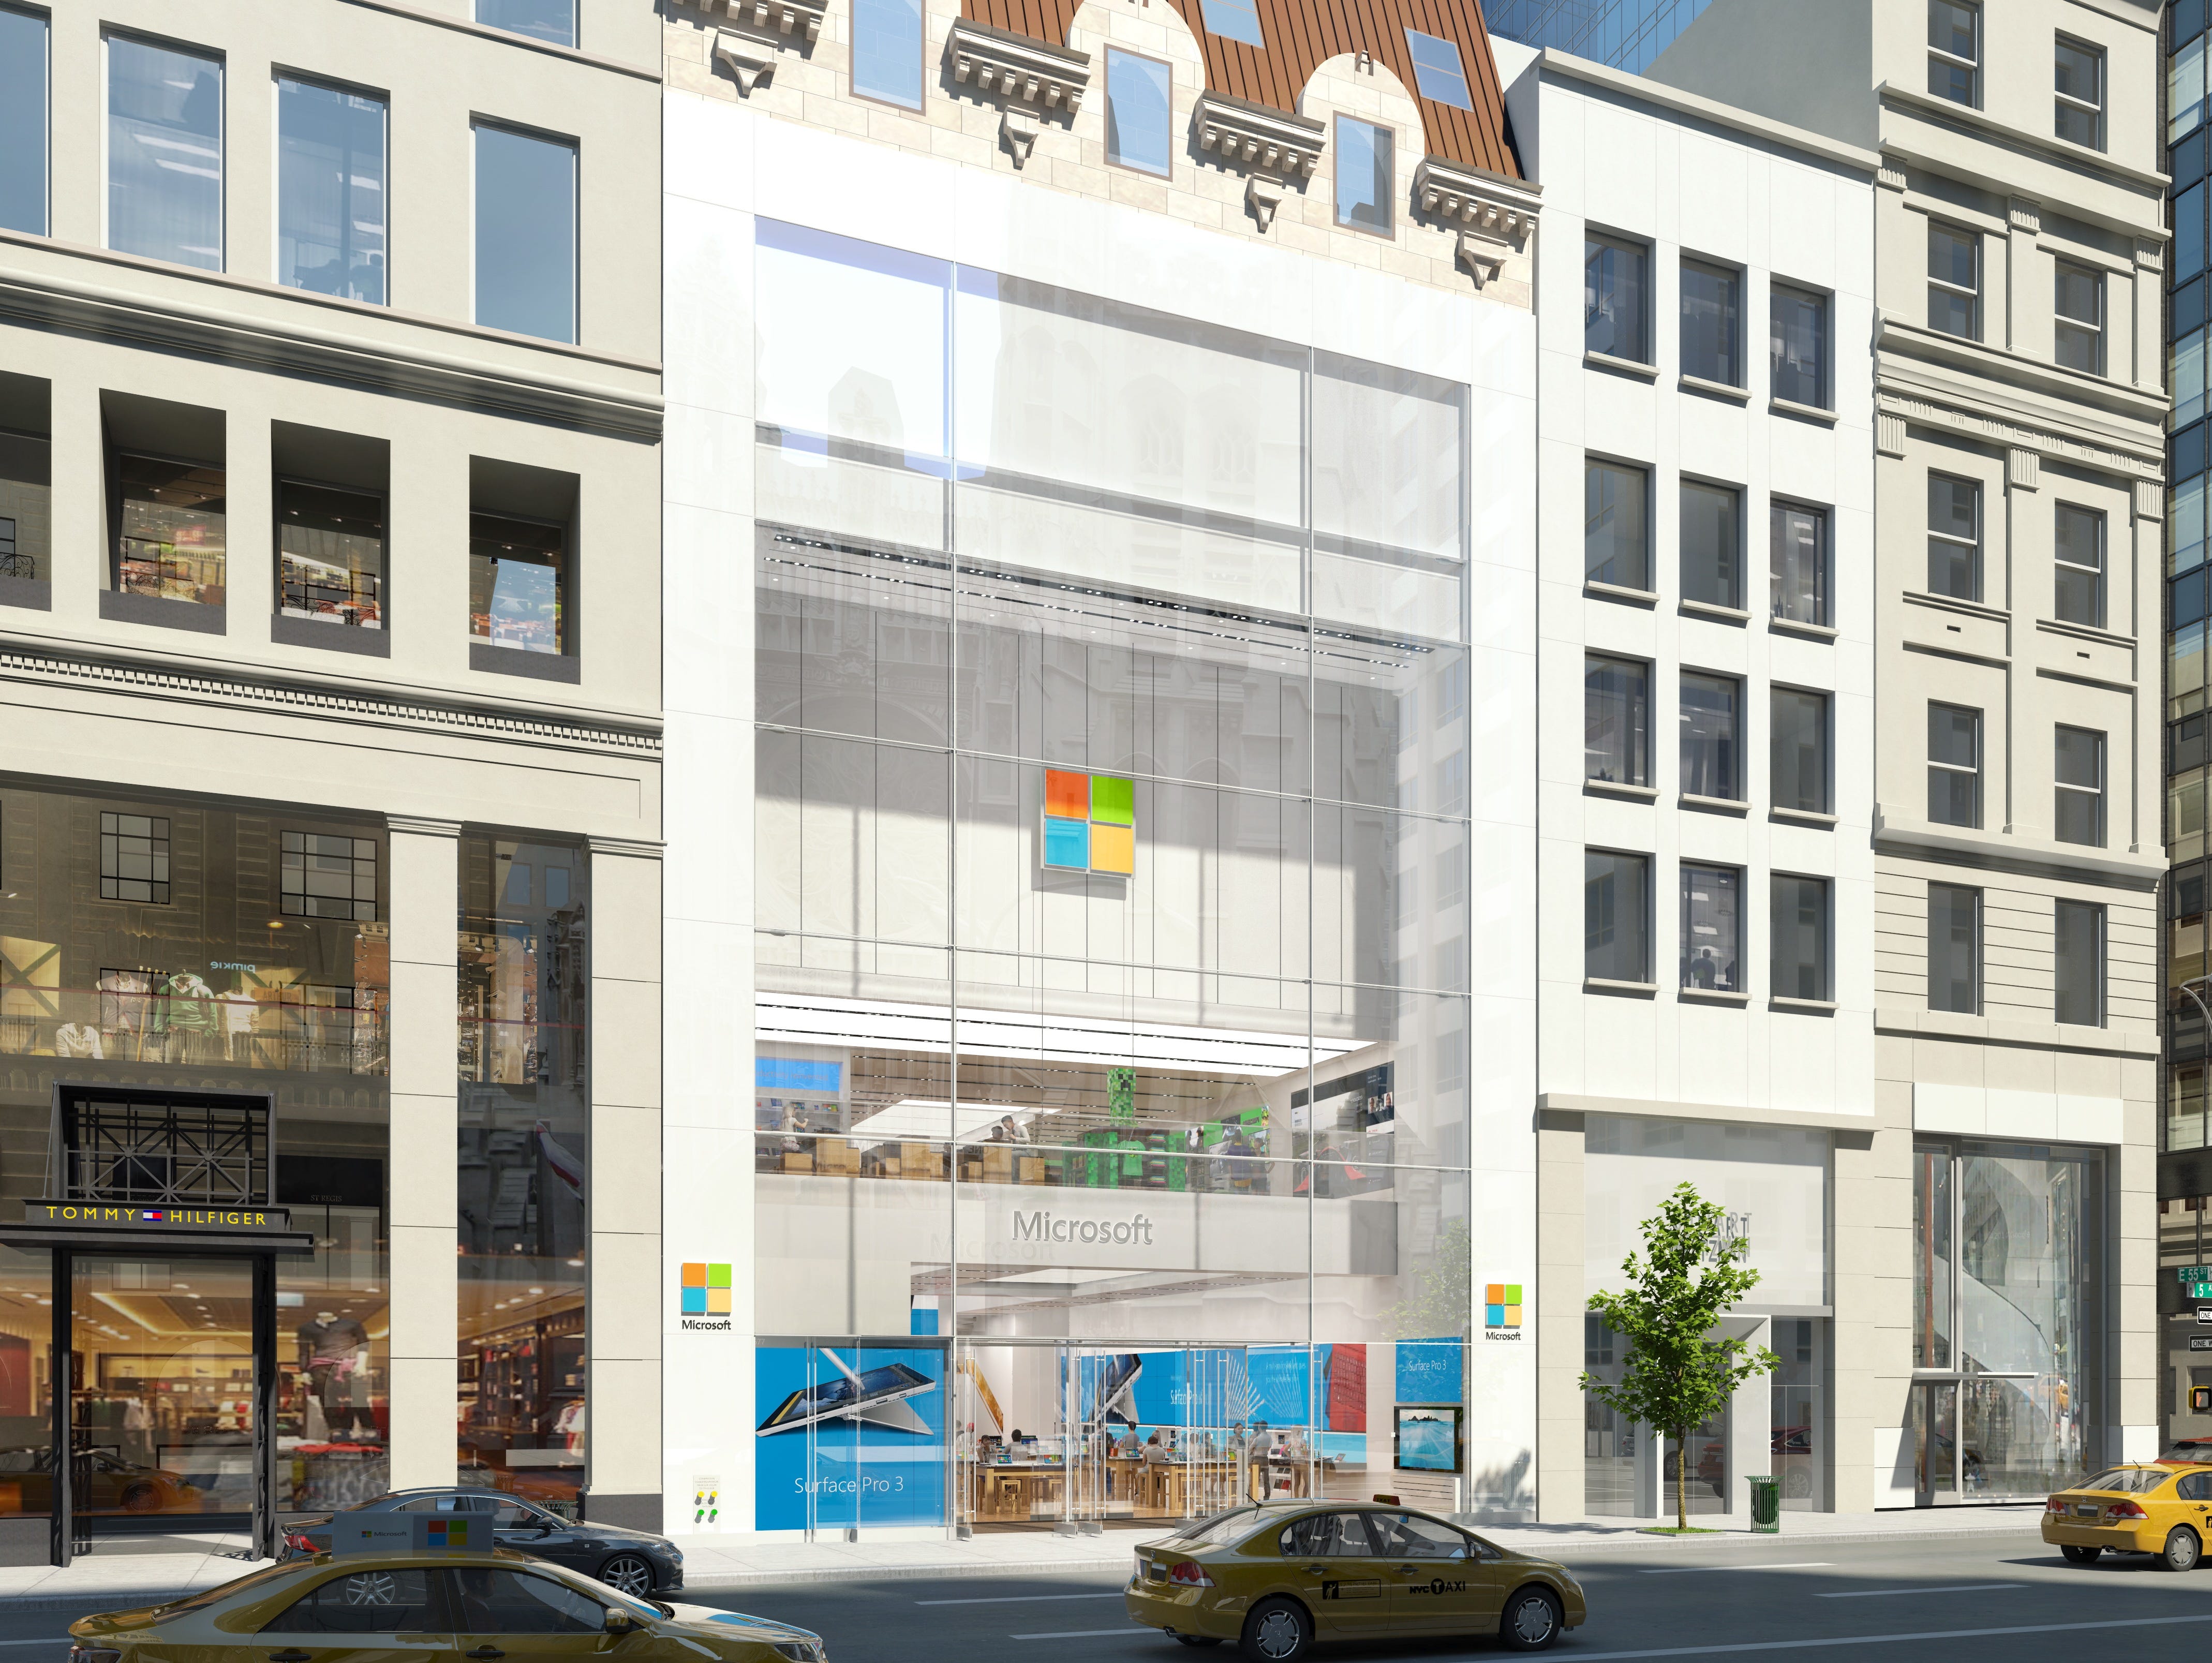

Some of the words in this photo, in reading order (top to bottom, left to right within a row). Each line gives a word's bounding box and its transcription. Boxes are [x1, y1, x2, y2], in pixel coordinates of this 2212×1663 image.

[46, 1206, 136, 1221] TOMMY
[170, 1210, 266, 1225] HILFIGER
[1012, 1211, 1153, 1245] Microsoft
[2179, 1269, 2185, 1282] E
[2188, 1268, 2199, 1281] 55
[2199, 1284, 2204, 1297] 5
[681, 1319, 731, 1330] Microsoft
[1486, 1331, 1521, 1341] Microsoft
[1409, 1361, 1430, 1371] Surface
[1431, 1360, 1441, 1370] Pro
[1443, 1359, 1446, 1370] 3
[795, 1476, 856, 1493] Surface
[863, 1477, 889, 1492] Pro
[895, 1476, 903, 1491] 3
[1409, 1585, 1430, 1594] NYC
[1431, 1579, 1465, 1594] TAXI
